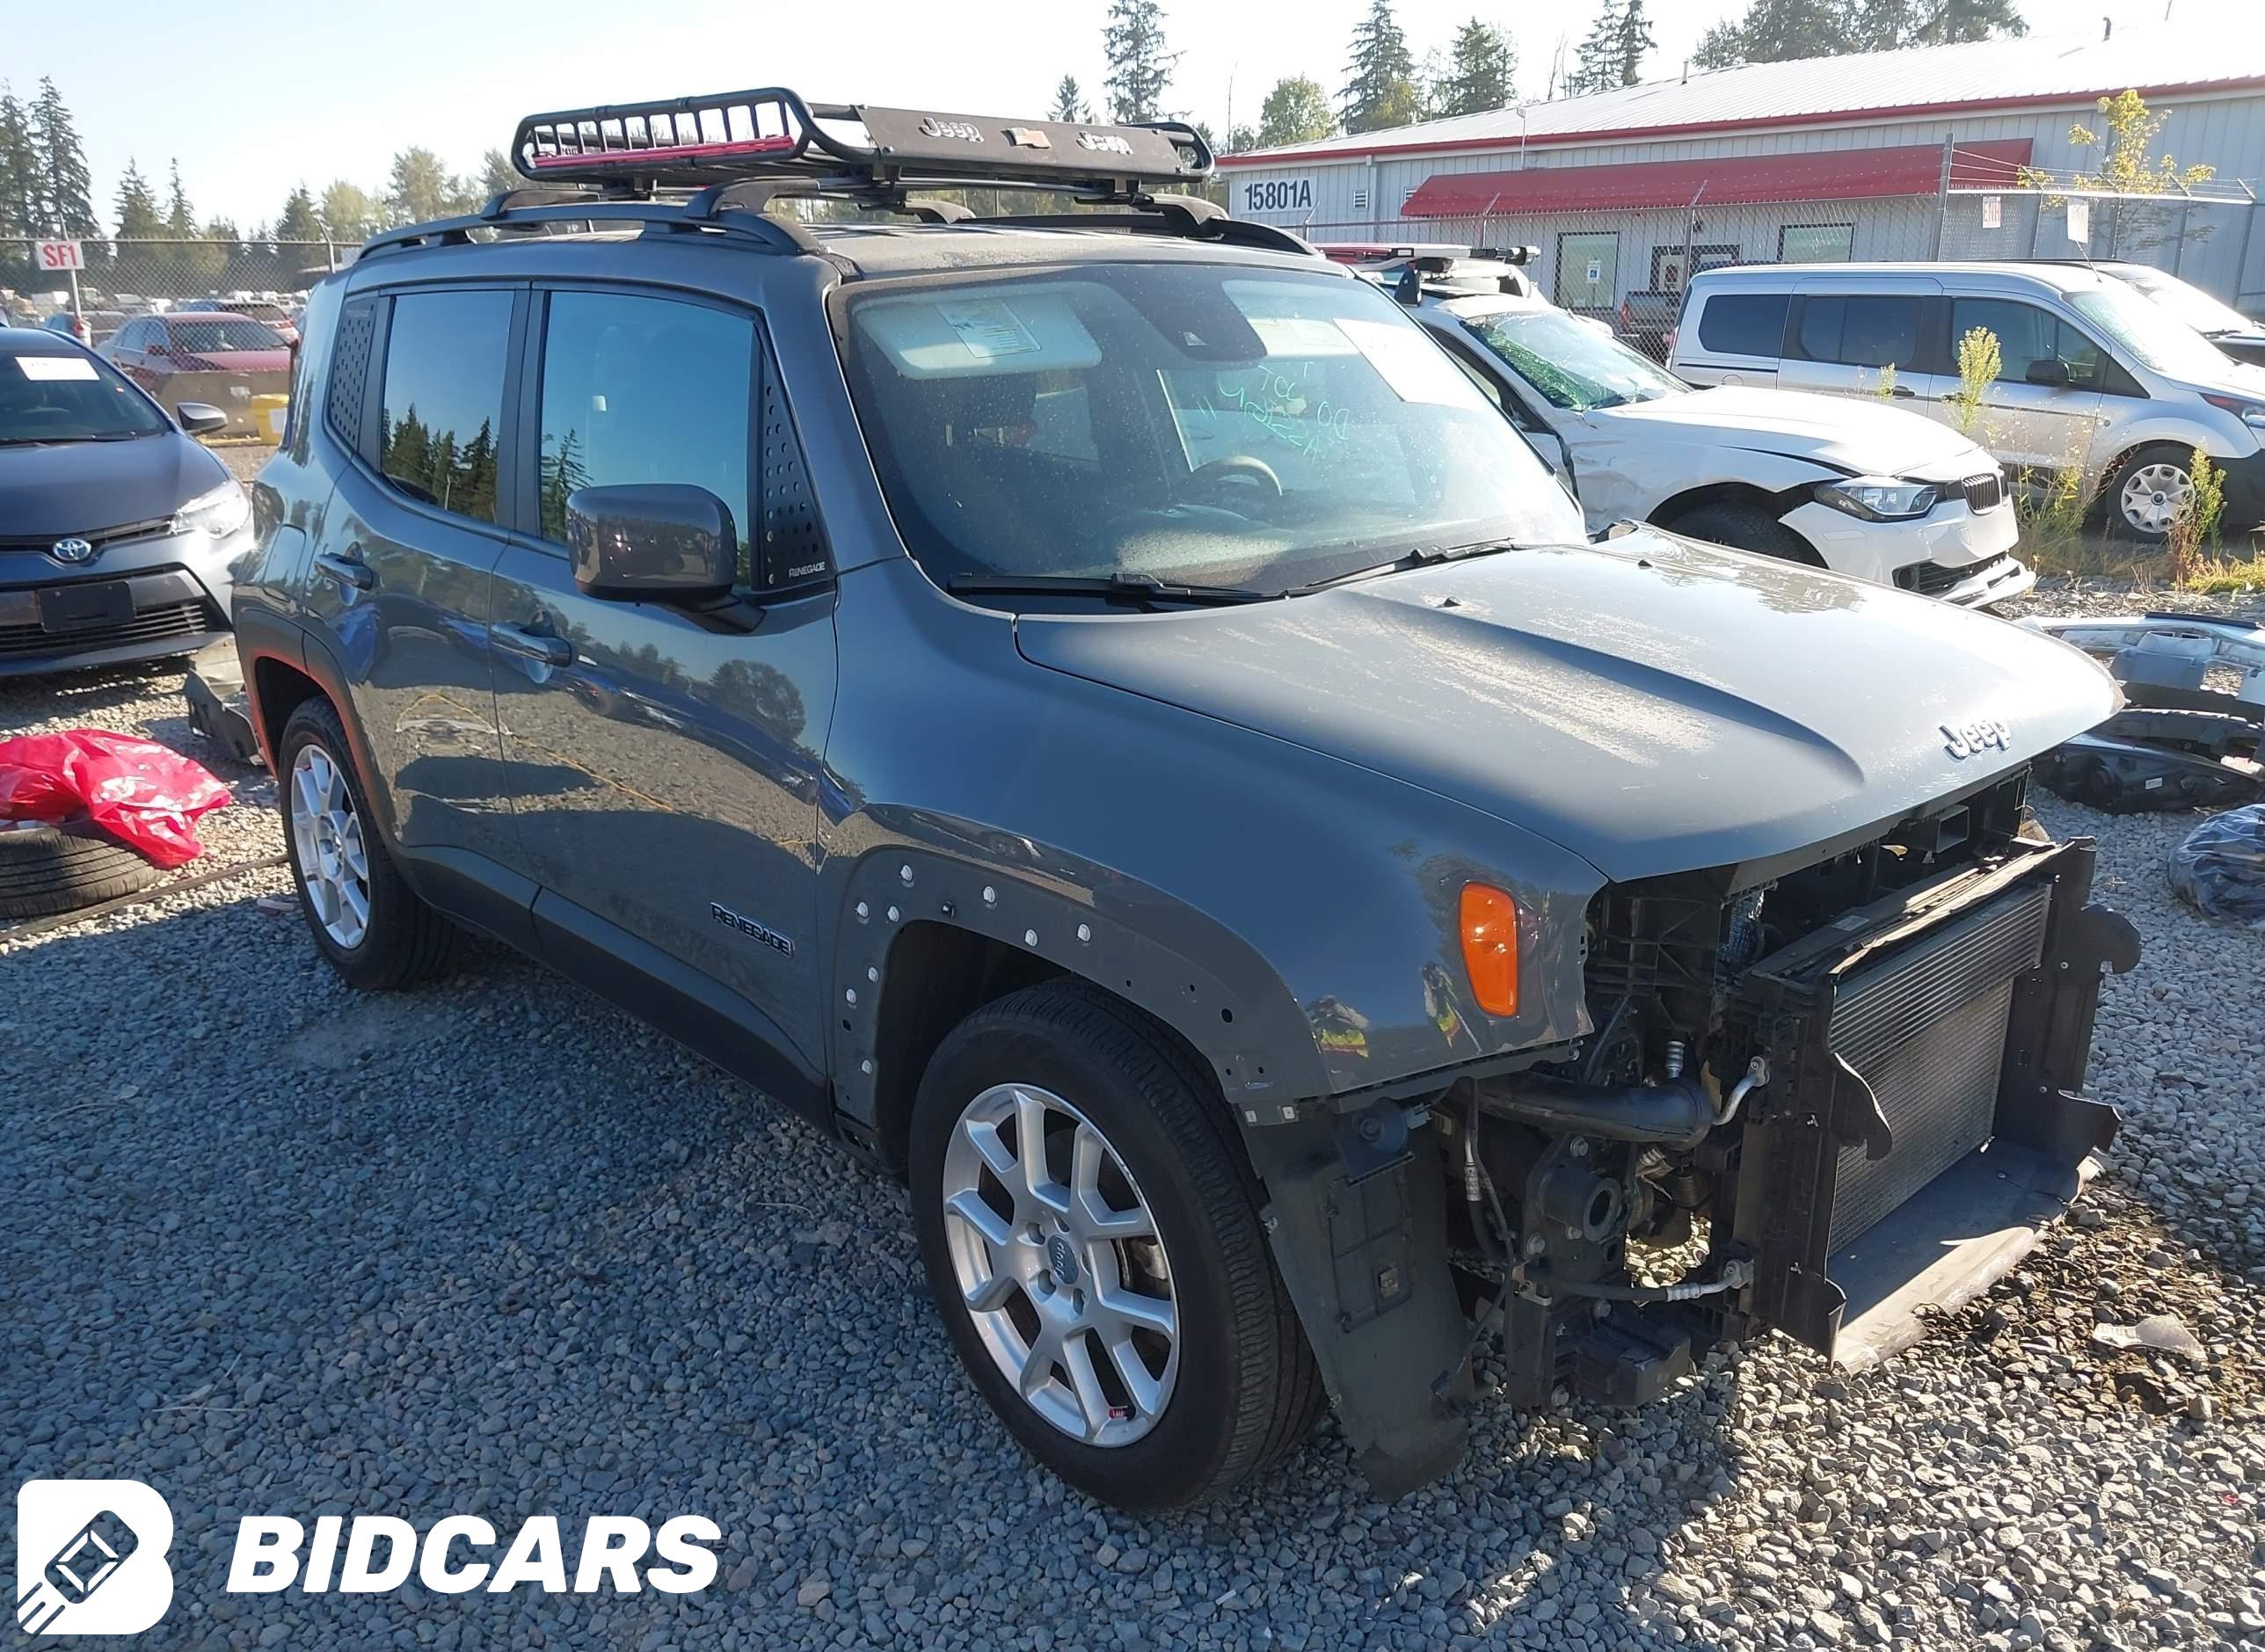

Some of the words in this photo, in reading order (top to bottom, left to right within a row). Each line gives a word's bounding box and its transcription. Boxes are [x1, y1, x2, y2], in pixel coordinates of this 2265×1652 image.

[919, 117, 984, 142] Jeep
[1076, 130, 1134, 156] Jeep
[1244, 179, 1313, 211] 15801A
[42, 244, 77, 267] SF1
[788, 561, 826, 579] RENEGADE
[1938, 719, 2012, 760] Jeep
[710, 902, 792, 957] RENEGADE
[1054, 1241, 1066, 1280] Jeep
